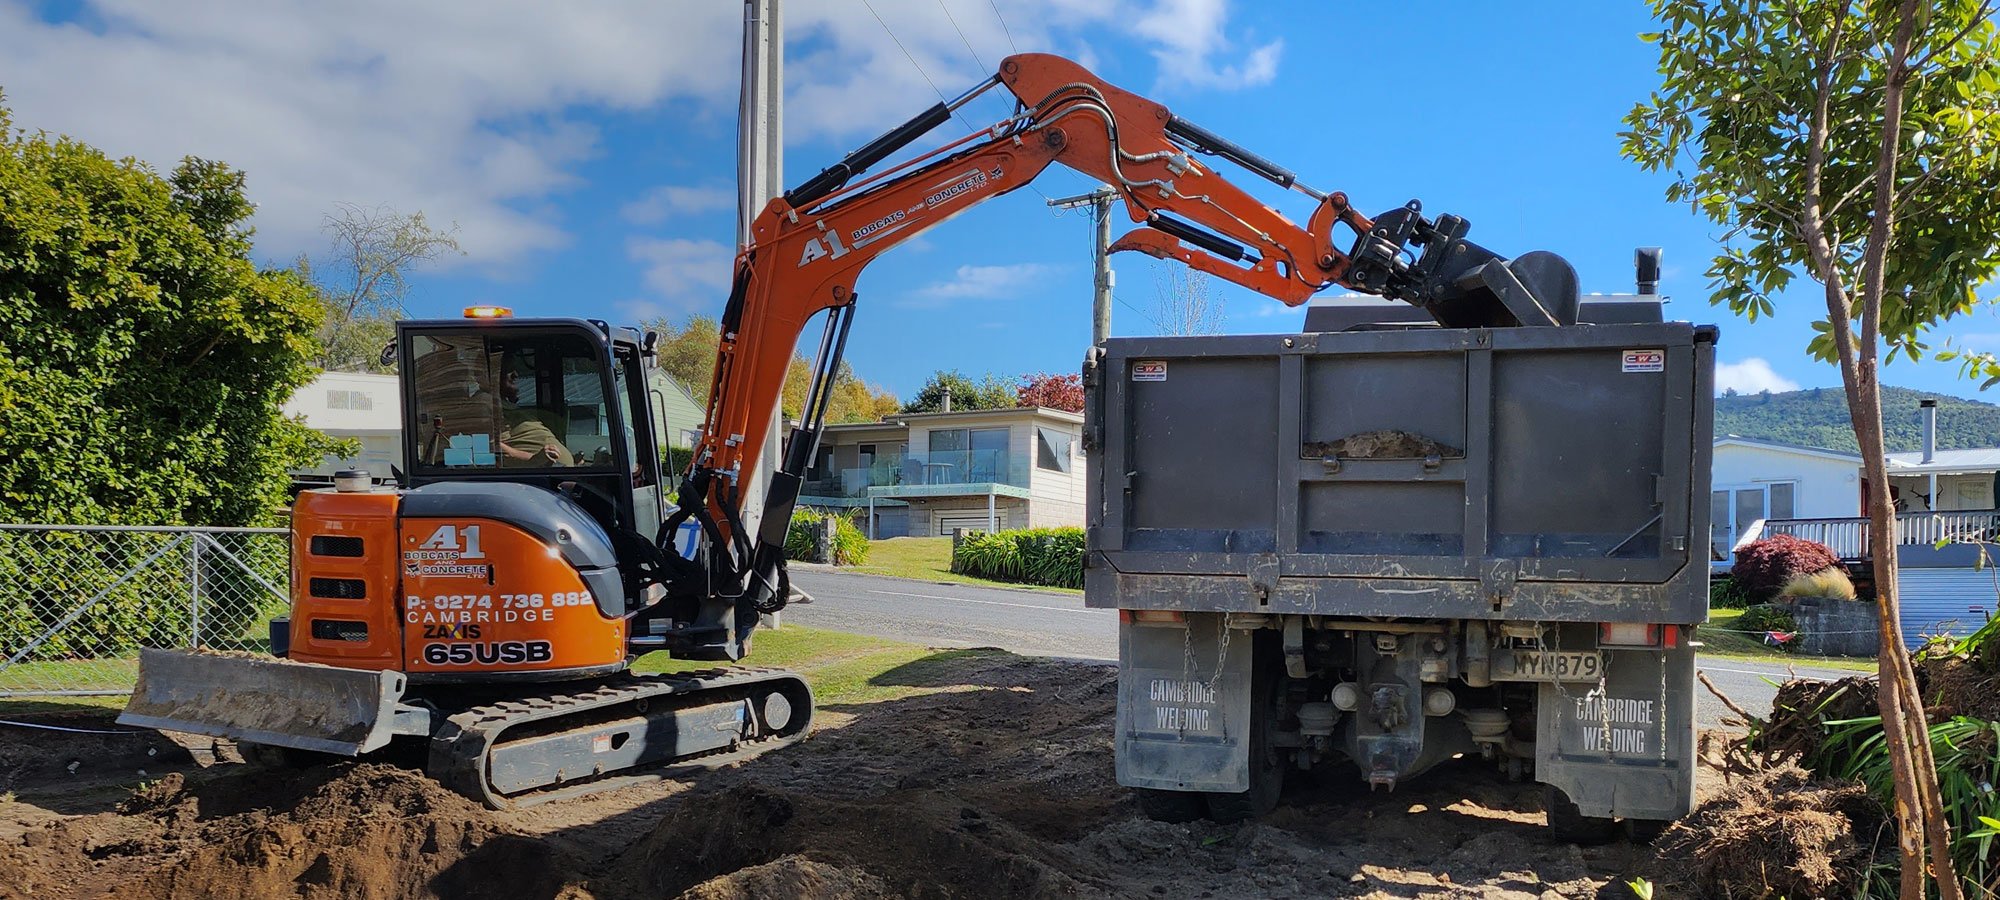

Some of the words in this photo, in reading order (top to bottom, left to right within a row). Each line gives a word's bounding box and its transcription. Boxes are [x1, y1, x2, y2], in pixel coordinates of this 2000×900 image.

[853, 210, 905, 240] BOBCATS
[926, 172, 987, 206] CONCRETE
[798, 228, 850, 268] A1
[419, 525, 485, 558] A1
[404, 550, 459, 560] BOBCATS
[422, 565, 486, 574] CONCRETE
[407, 595, 426, 610] P:
[434, 594, 492, 609] 0274
[500, 593, 544, 609] 736
[552, 591, 592, 606] 882
[407, 609, 554, 623] CAMBRIDGE
[424, 621, 481, 640] ZAXIS
[424, 640, 552, 666] 65USB
